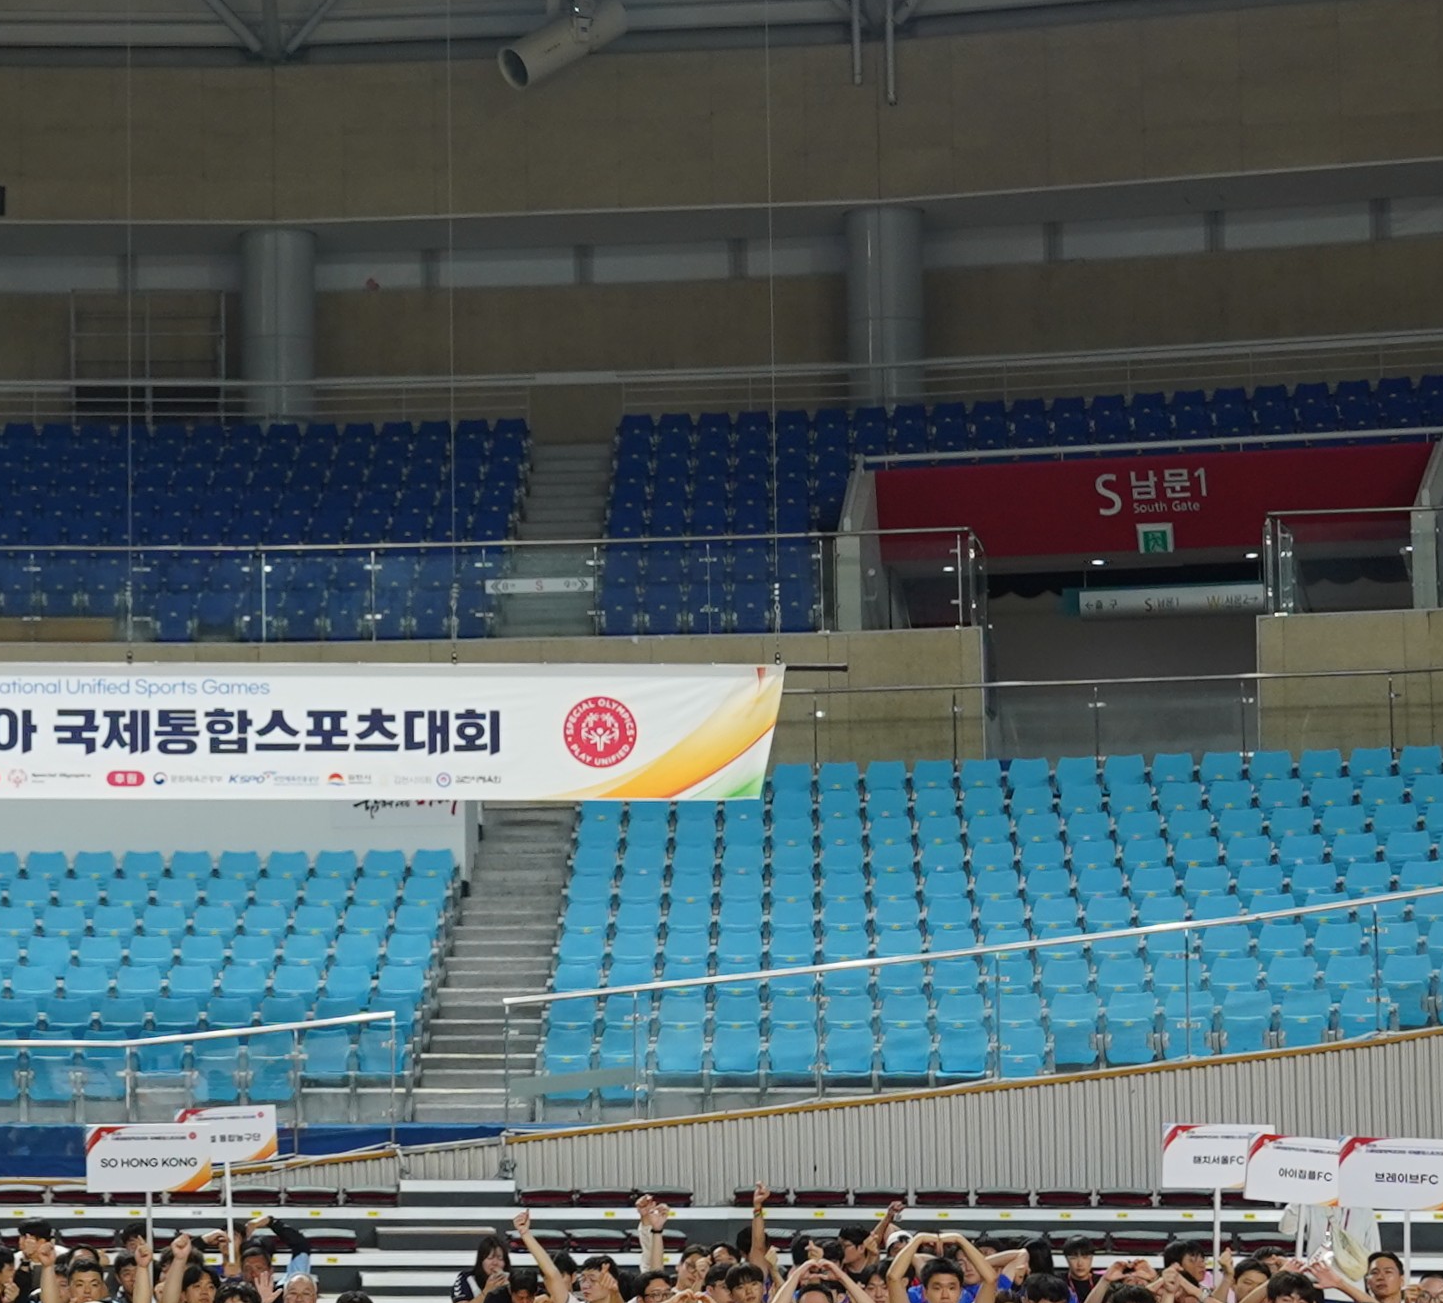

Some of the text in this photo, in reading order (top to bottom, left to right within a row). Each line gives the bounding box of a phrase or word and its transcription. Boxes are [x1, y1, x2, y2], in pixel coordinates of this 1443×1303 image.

[1095, 467, 1207, 516] S 남문1
[1133, 500, 1200, 514] South Gate
[1145, 598, 1153, 611] S
[66, 679, 130, 695] Unified
[135, 679, 197, 699] Sports
[202, 679, 271, 695] Games
[566, 698, 635, 736] SPECIAL OLYMPICS
[54, 708, 501, 755] 국제통합스포츠대회
[570, 744, 630, 766] PLAY UNIFIED
[100, 1157, 197, 1168] SO HONG KONG
[1375, 1172, 1438, 1185] 브레이브FC
